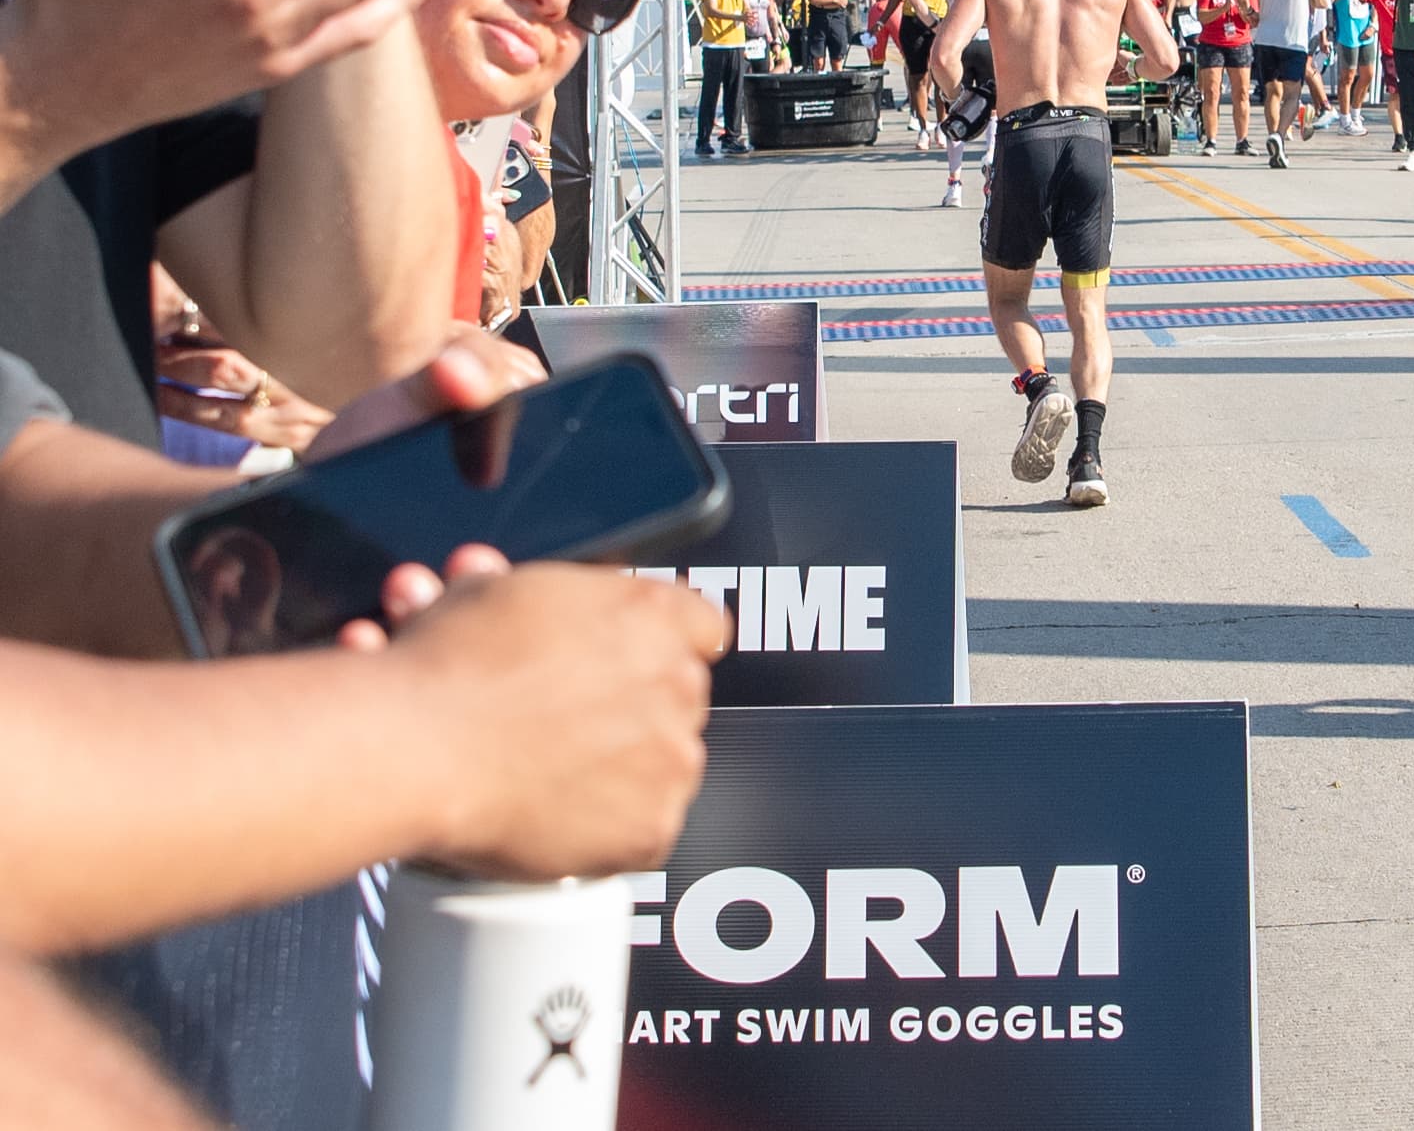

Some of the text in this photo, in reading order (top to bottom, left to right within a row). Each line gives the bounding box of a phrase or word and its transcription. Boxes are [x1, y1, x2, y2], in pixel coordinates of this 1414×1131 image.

[688, 565, 887, 652] TIME
[618, 1004, 1124, 1045] ART SWIM GOGGLES
